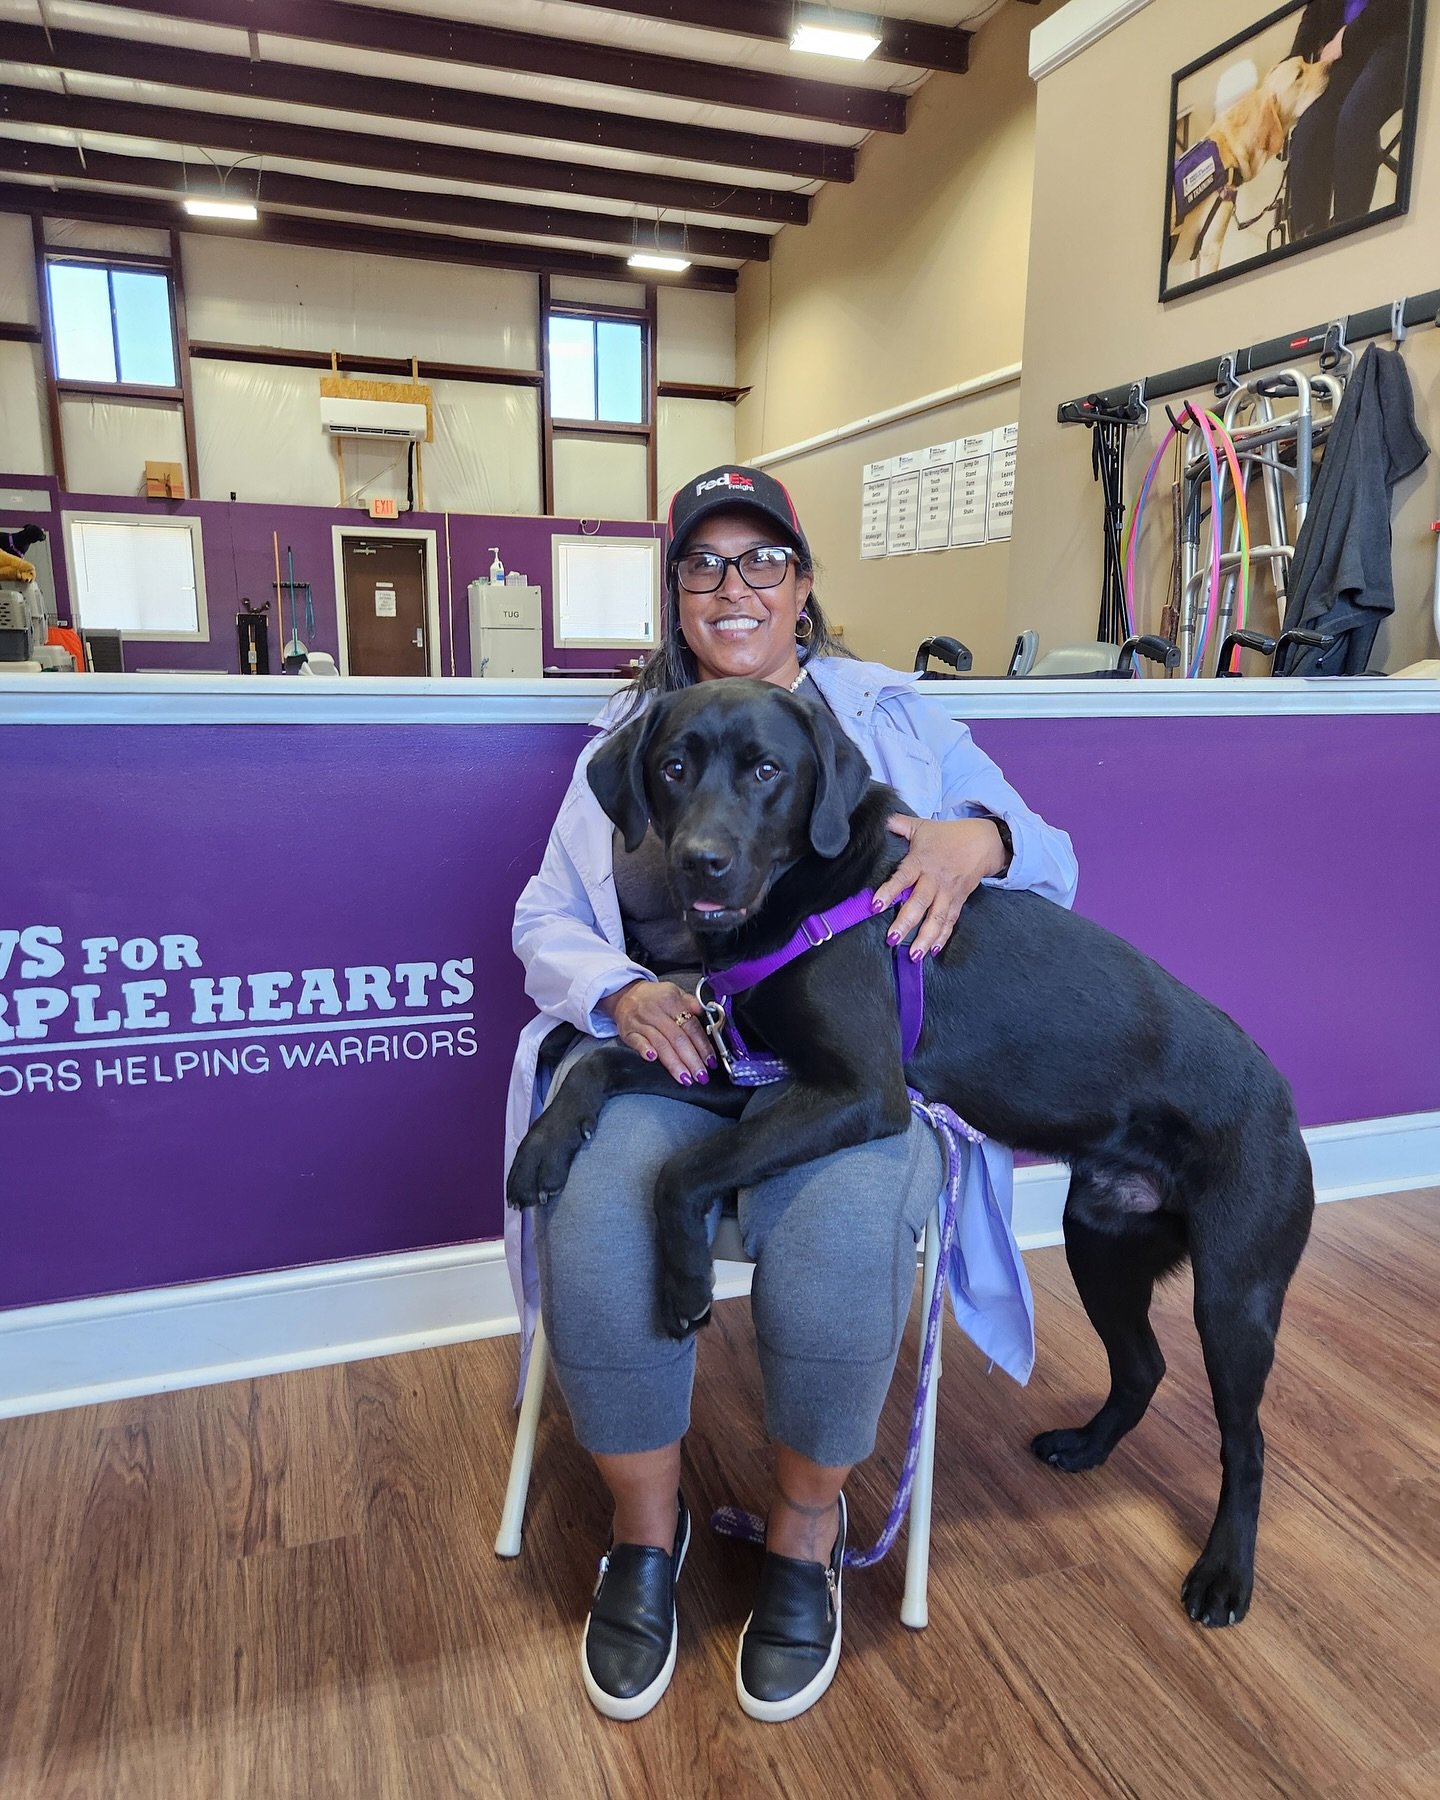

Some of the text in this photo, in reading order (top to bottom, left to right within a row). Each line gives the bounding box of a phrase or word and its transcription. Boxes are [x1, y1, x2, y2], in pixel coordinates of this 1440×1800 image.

[696, 473, 753, 496] FedEx
[728, 484, 755, 492] Freight
[374, 499, 394, 515] EXIT
[81, 934, 203, 974] FOR
[0, 958, 474, 1041] PLE HEARTS
[95, 1044, 270, 1088] HELPING
[279, 1027, 478, 1069] WARRIORS
